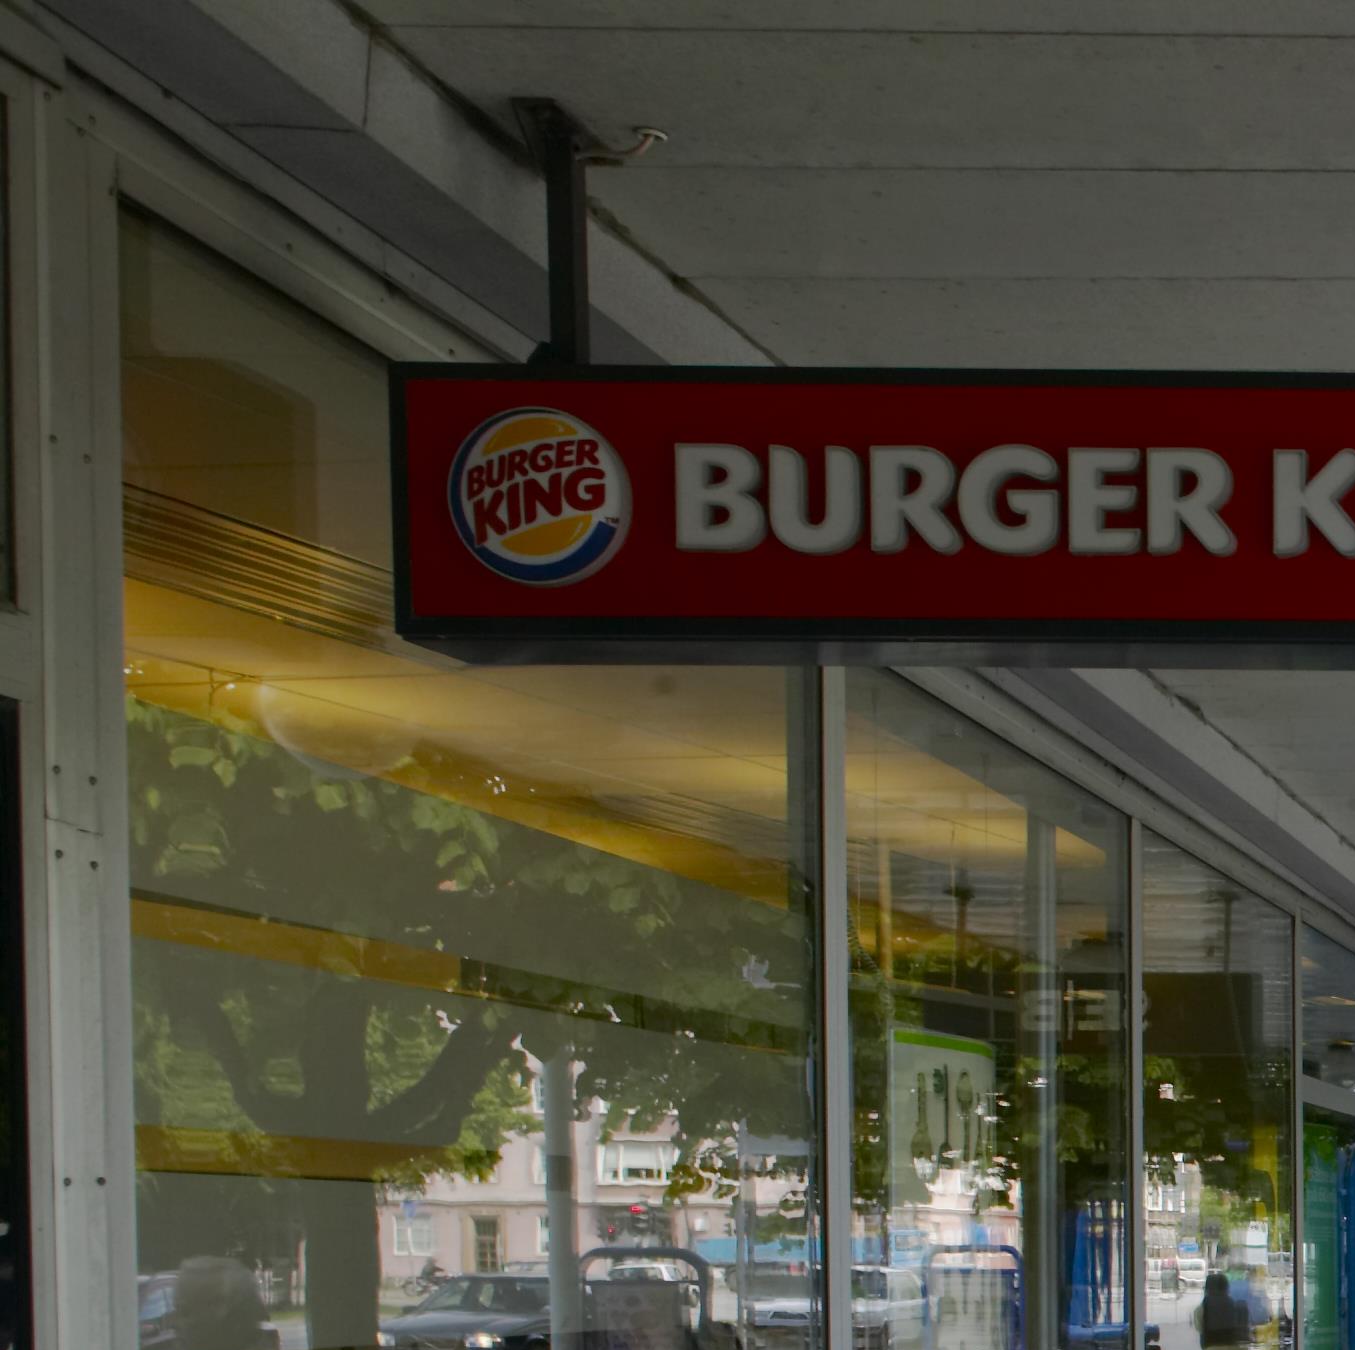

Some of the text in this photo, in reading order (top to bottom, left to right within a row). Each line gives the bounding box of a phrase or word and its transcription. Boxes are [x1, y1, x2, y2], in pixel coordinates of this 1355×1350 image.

[467, 438, 600, 501] BURGER
[473, 466, 607, 546] KING
[674, 443, 1240, 560] BURGER
